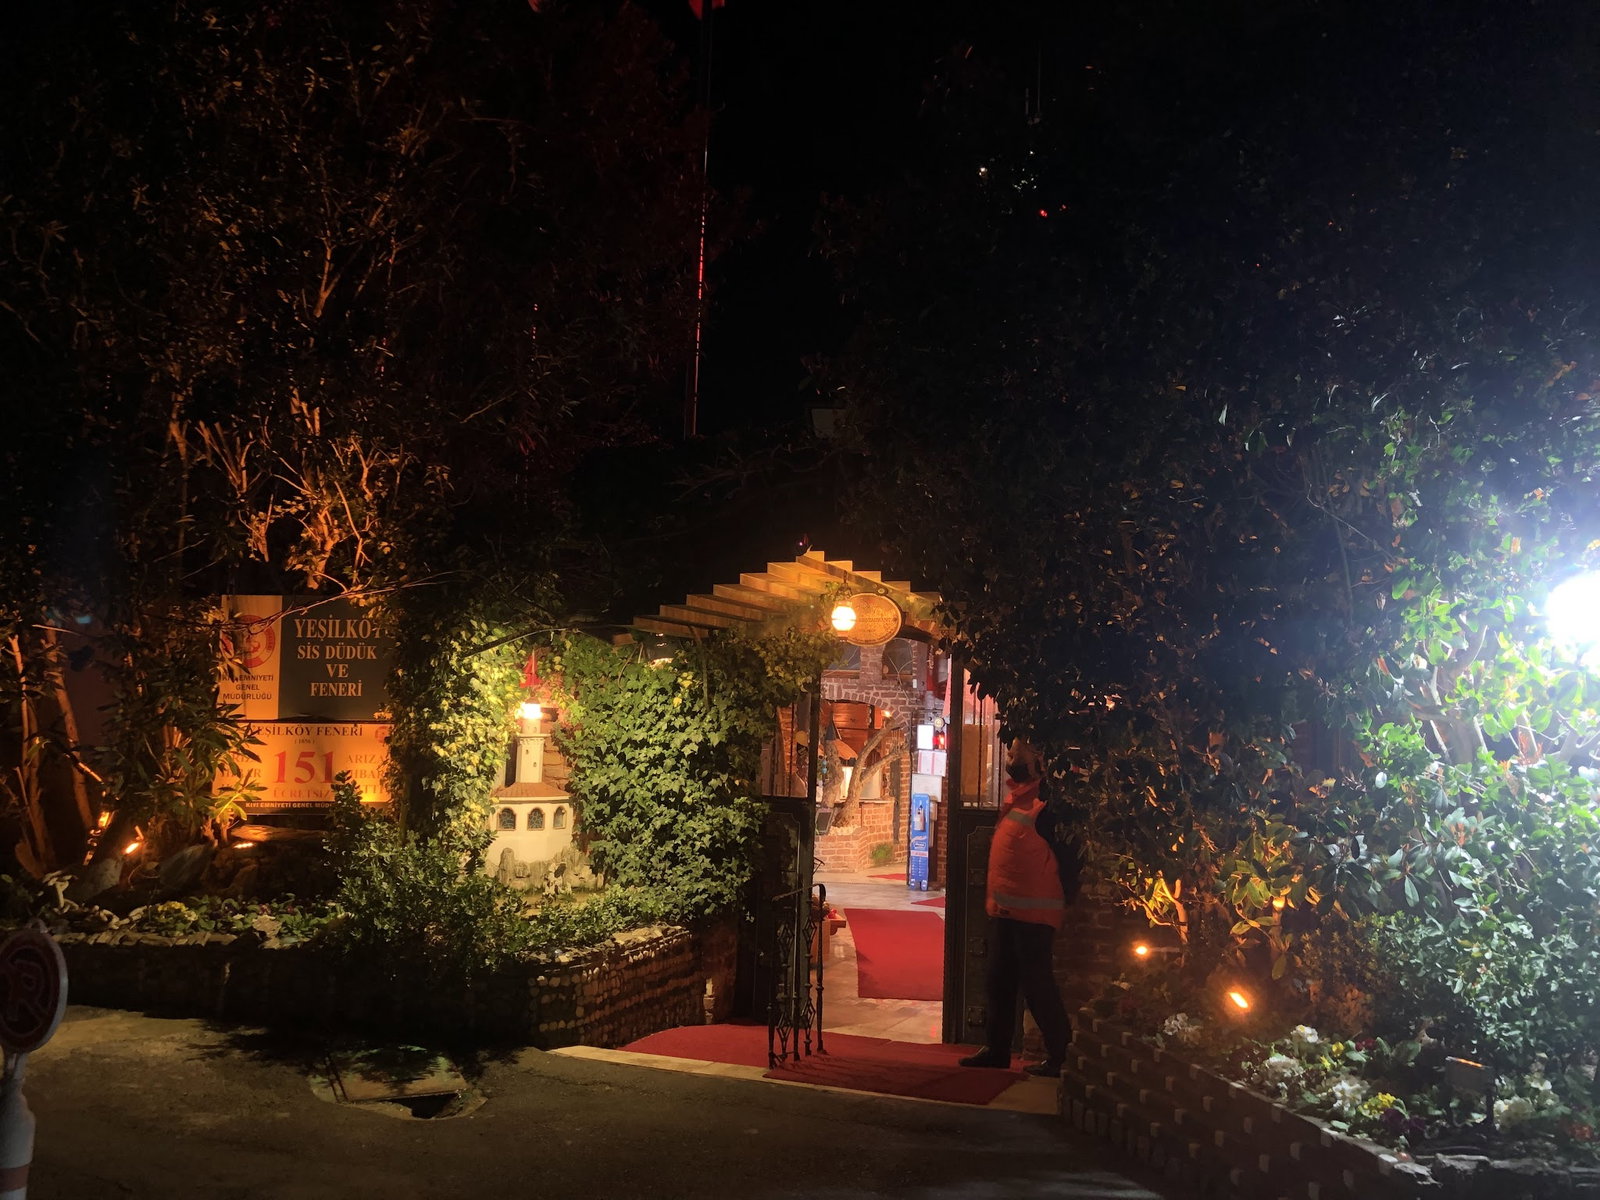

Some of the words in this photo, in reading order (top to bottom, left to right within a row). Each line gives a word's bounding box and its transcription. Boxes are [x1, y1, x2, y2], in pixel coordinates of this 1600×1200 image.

[297, 642, 320, 660] SİS
[325, 642, 377, 660] DÜDÜK
[326, 663, 349, 678] VE
[310, 680, 362, 697] FENERİ
[316, 725, 363, 736] FENERİ
[273, 751, 334, 784] 151
